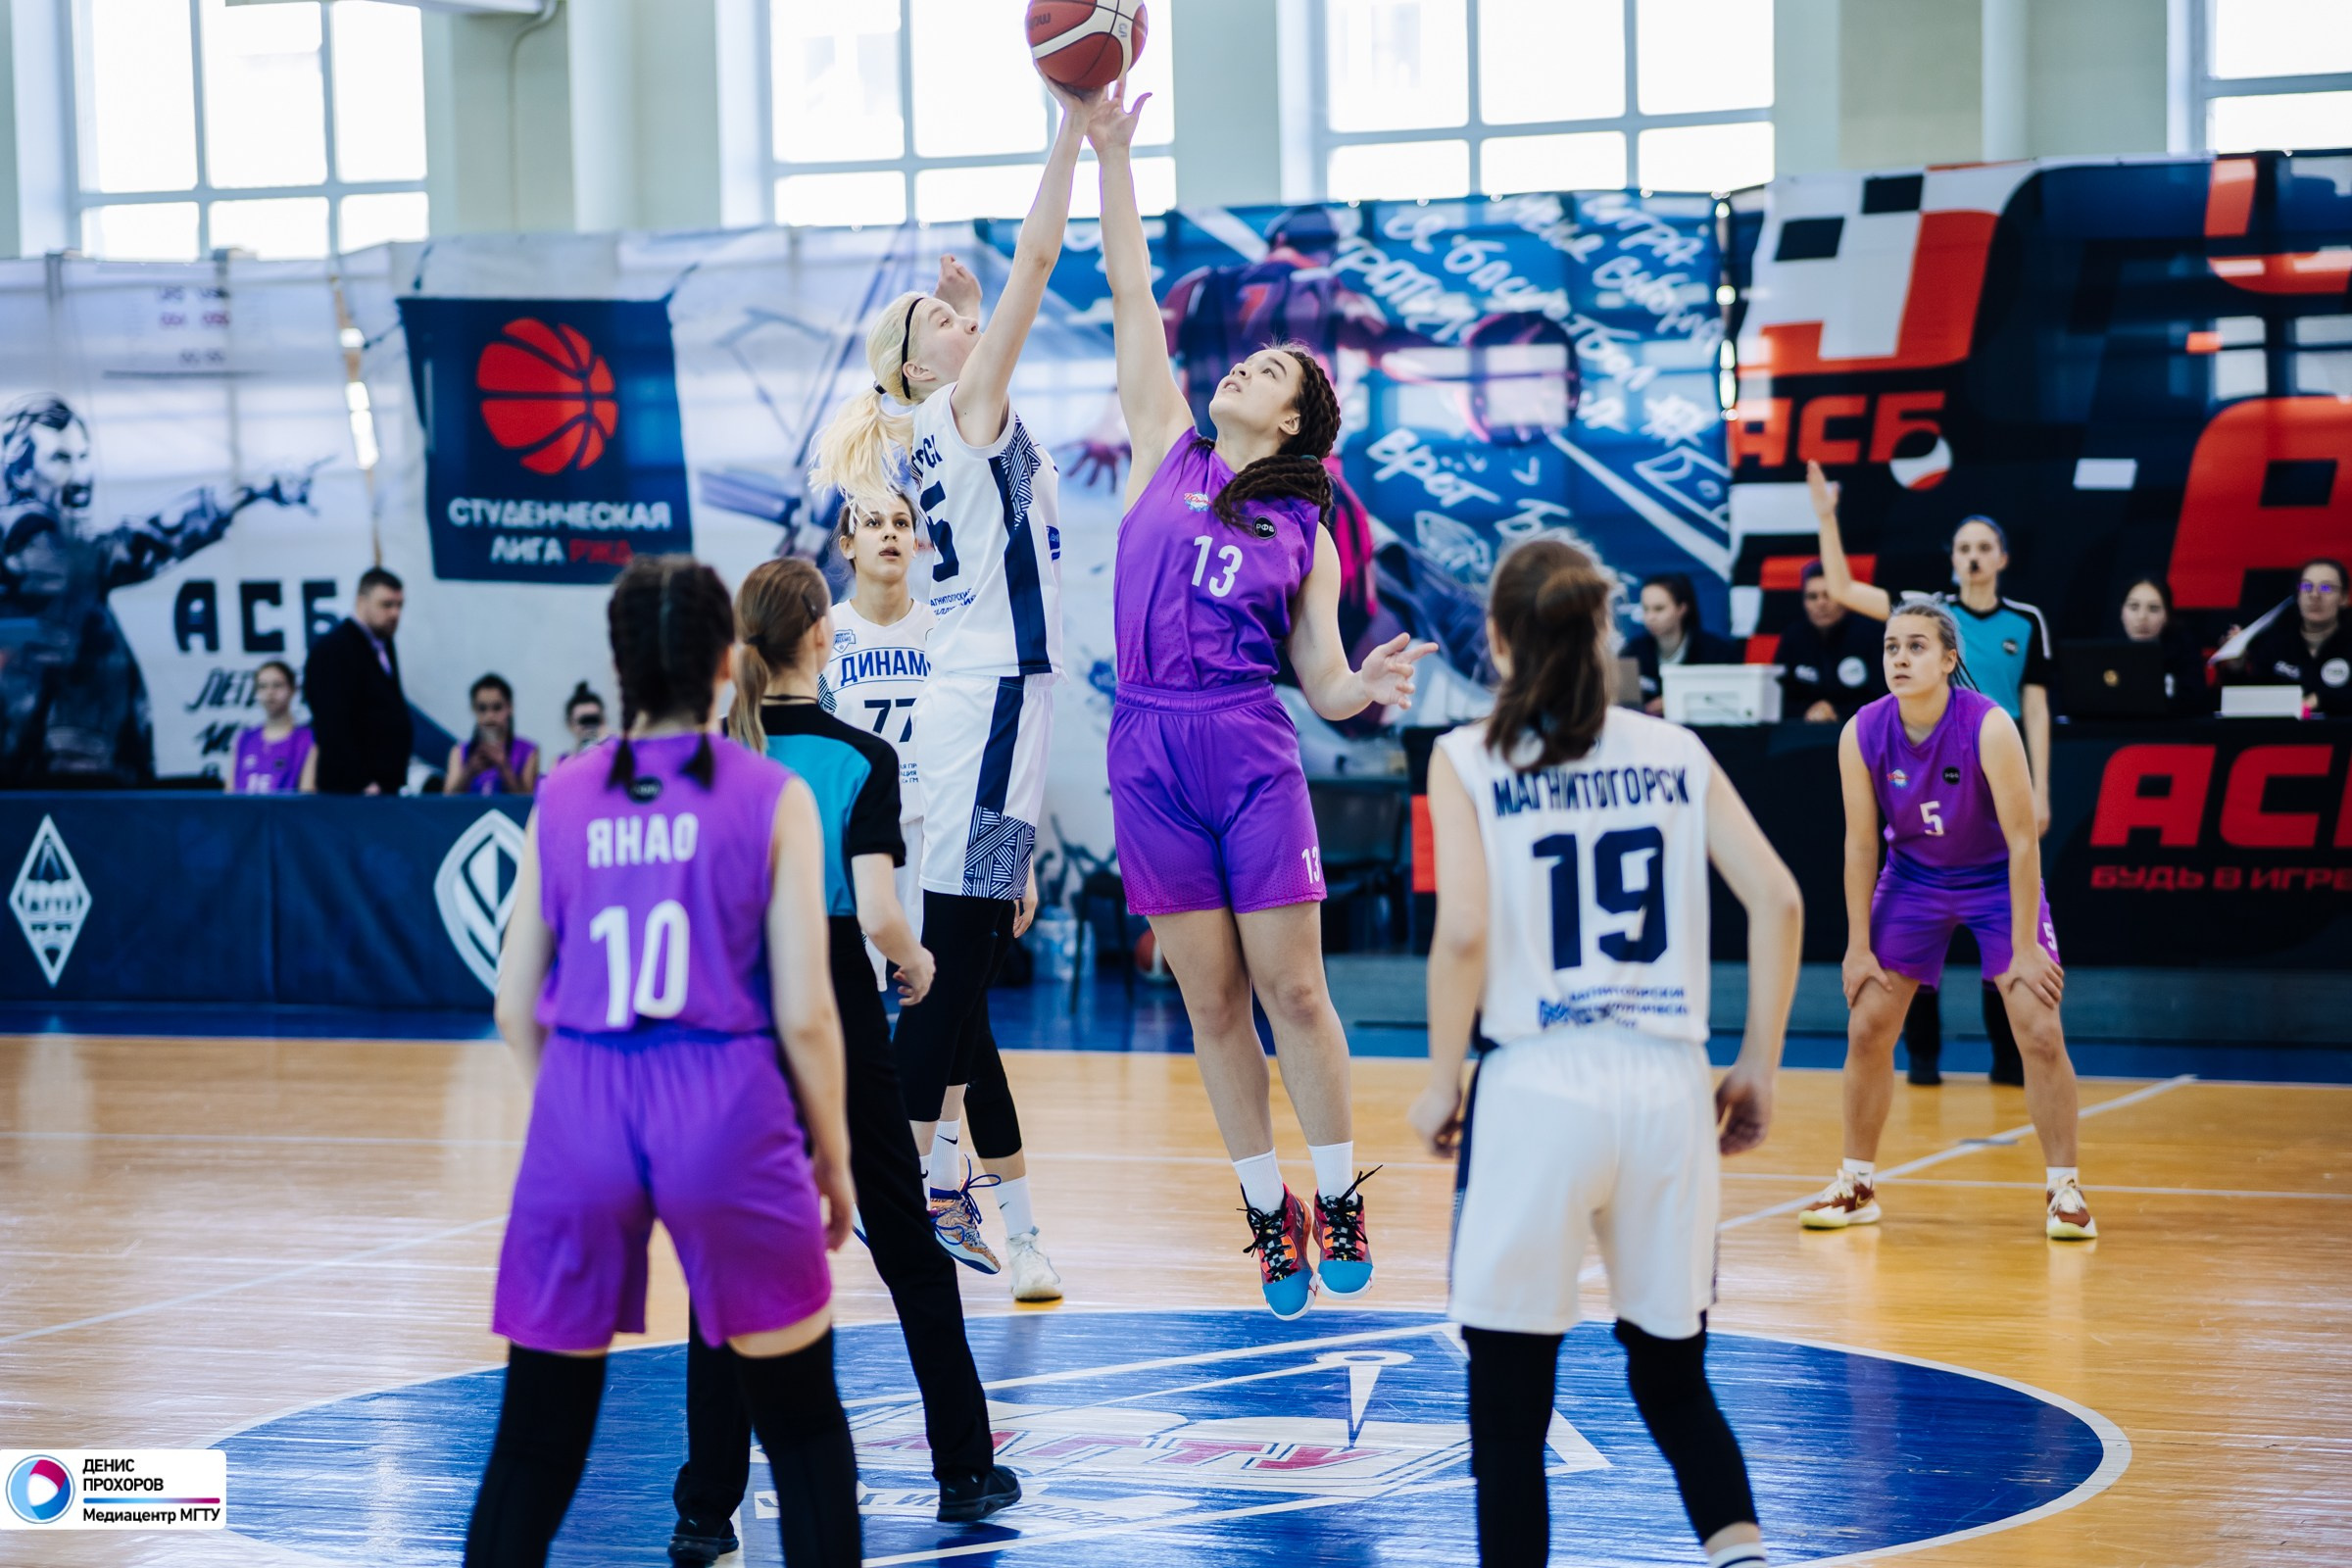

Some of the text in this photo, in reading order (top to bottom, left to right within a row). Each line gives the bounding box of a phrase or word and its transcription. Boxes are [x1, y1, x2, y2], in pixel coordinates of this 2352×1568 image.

[448, 497, 672, 531] СТУДЕНЧЕСКАЯ
[491, 535, 634, 566] ЛИГА РЖД
[1191, 534, 1244, 598] 13
[173, 579, 339, 654] АСБ
[840, 650, 931, 687] ДИНАМ
[863, 697, 917, 743] 77
[1494, 767, 1690, 816] МАГНИТОГОРСК
[2090, 743, 2352, 848] АС
[586, 811, 699, 869] ЯНАО
[1920, 800, 1944, 837] 5
[1301, 846, 1320, 884] 13
[2090, 865, 2204, 892] БУДЬ
[2212, 866, 2242, 891] В
[1532, 825, 1668, 971] 19
[2042, 921, 2058, 952] 5
[589, 898, 691, 1028] 10
